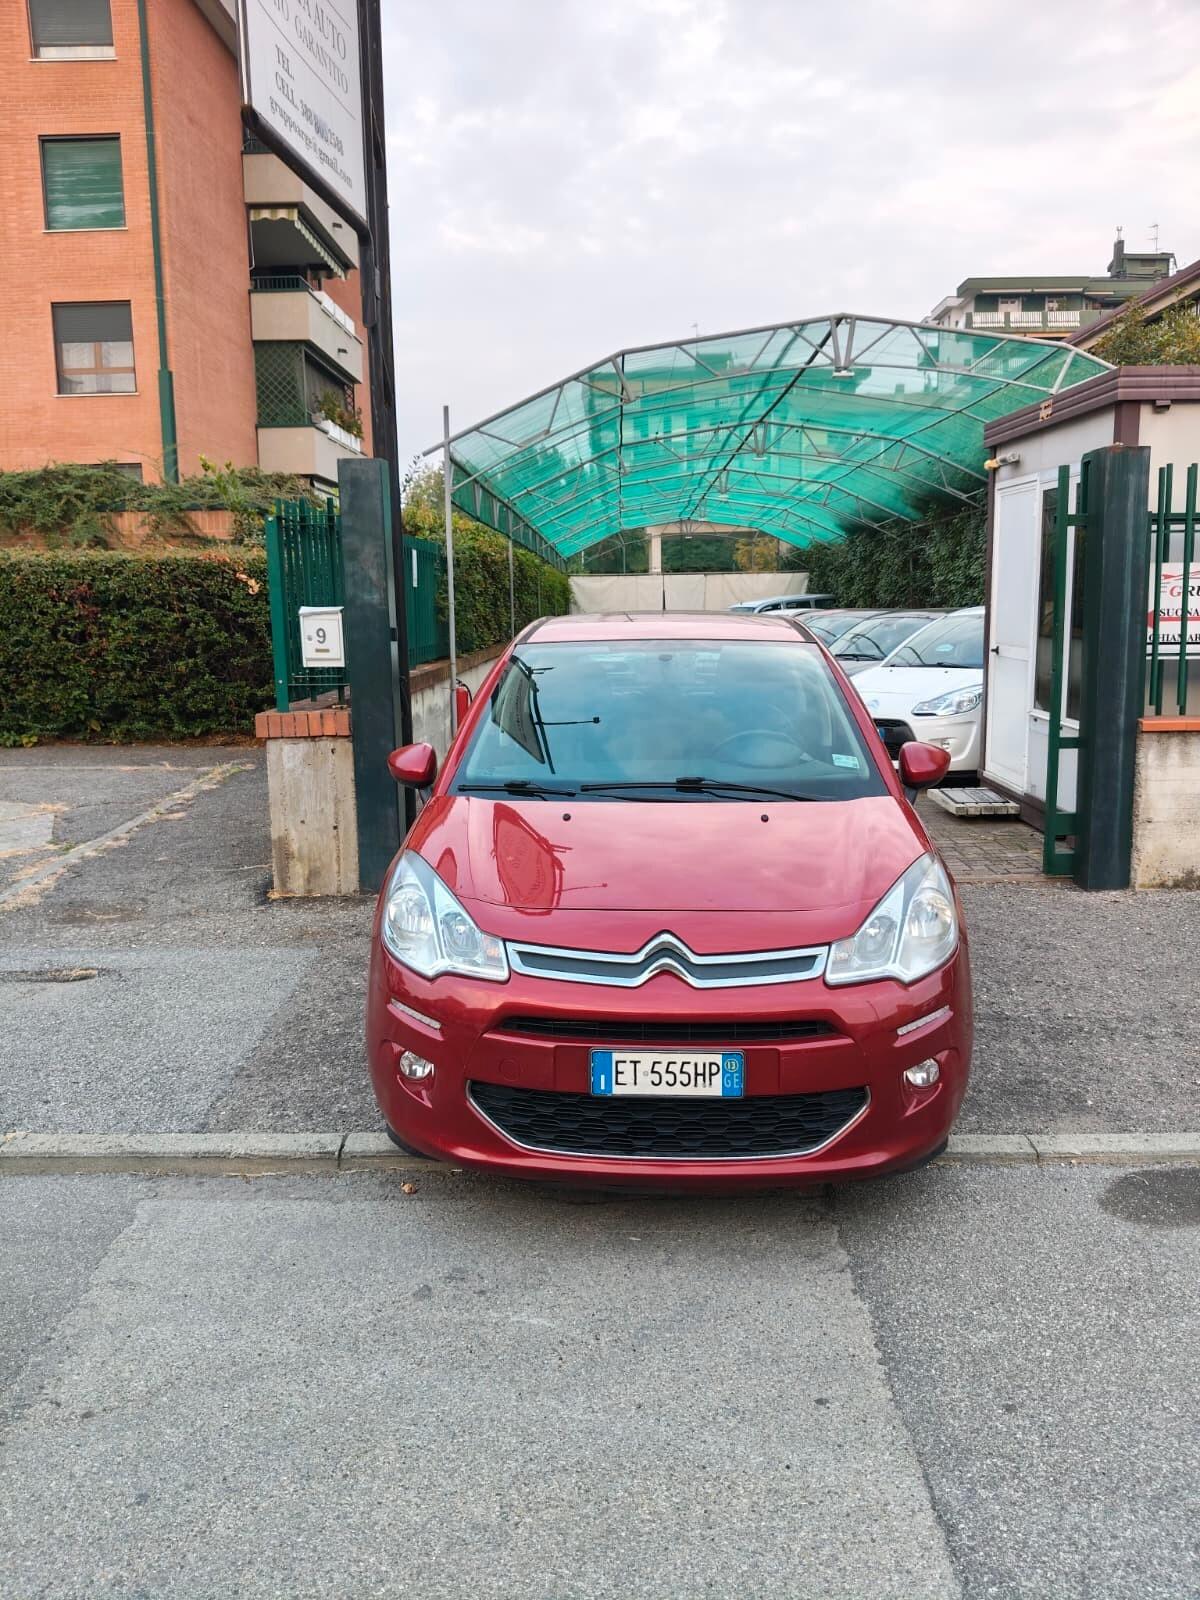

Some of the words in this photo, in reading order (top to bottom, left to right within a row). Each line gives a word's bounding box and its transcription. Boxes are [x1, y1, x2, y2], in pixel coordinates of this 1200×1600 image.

[313, 2, 346, 60] AUTO
[275, 44, 295, 81] TEL.
[294, 15, 349, 95] GARANTITO
[316, 627, 327, 644] 9
[600, 1074, 606, 1090] I
[615, 1060, 641, 1086] ET
[650, 1061, 721, 1088] 555HP
[723, 1073, 740, 1089] GE
